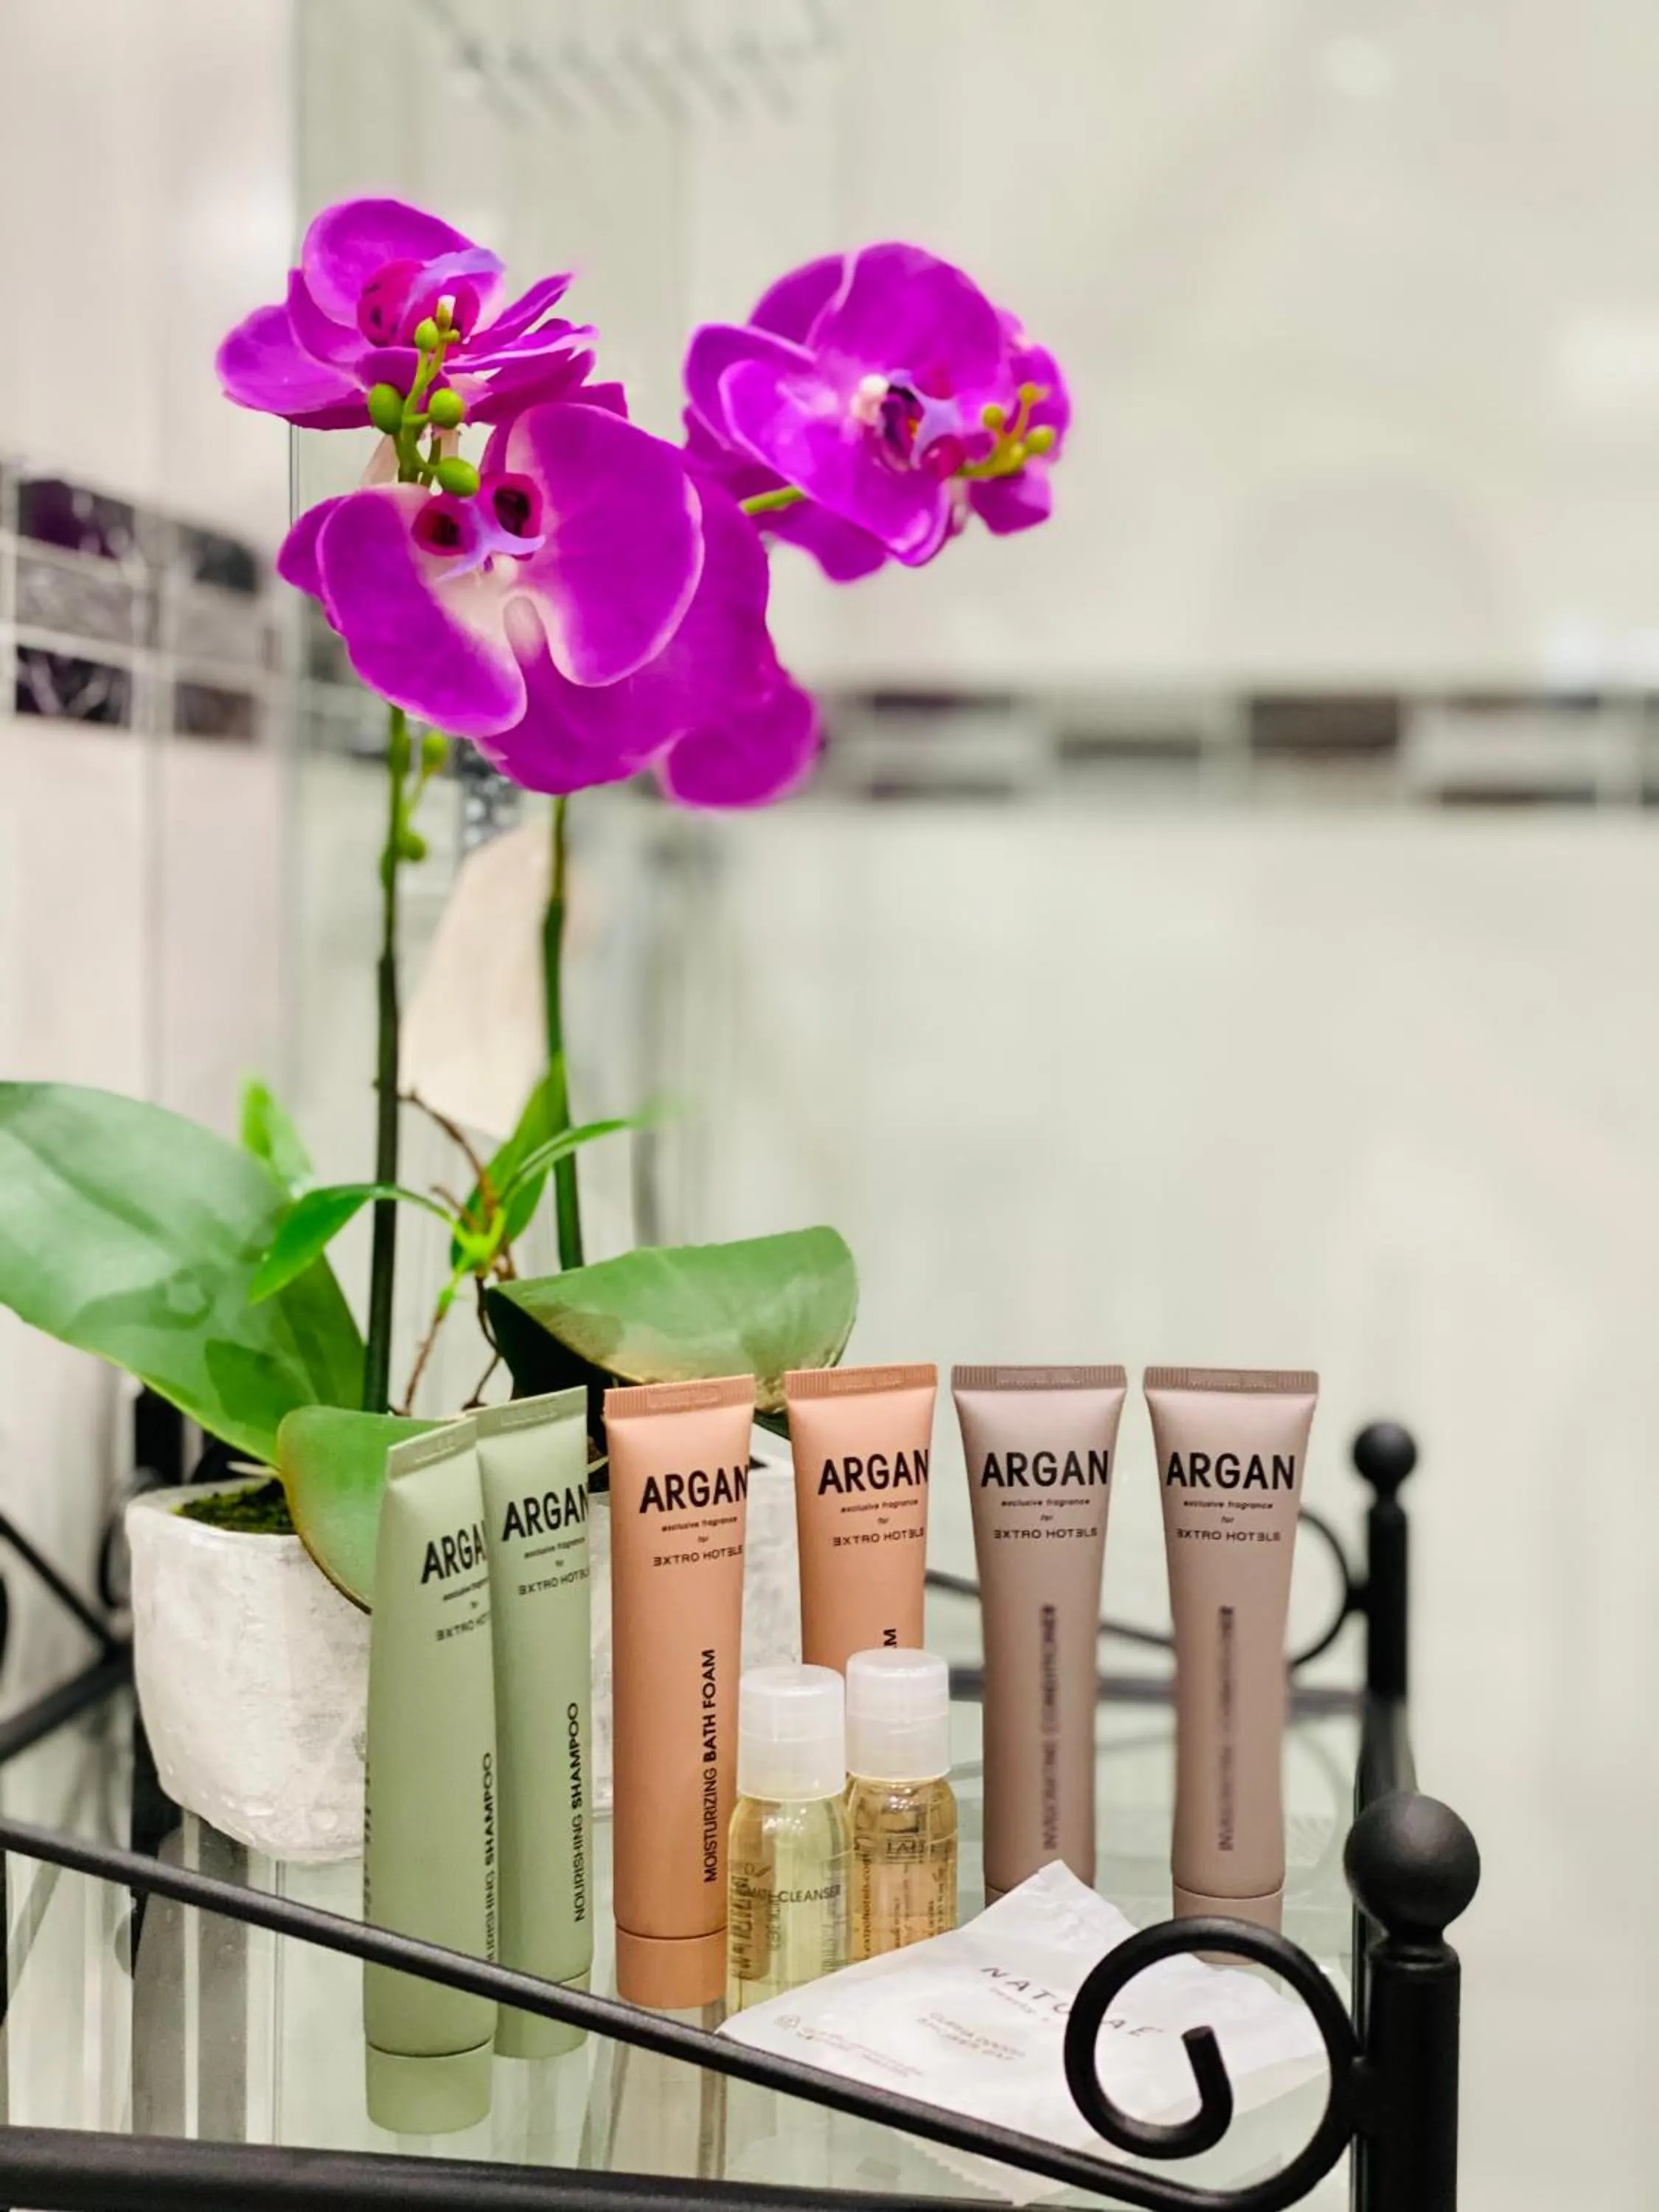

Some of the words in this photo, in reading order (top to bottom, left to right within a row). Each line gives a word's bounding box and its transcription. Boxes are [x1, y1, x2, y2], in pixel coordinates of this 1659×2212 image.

[639, 1464, 748, 1514] ARGAN
[818, 1449, 928, 1495] ARGAN
[981, 1450, 1107, 1487] ARGAN
[1166, 1452, 1295, 1489] ARGAN
[421, 1520, 487, 1584] ARGA
[701, 1649, 716, 1708] FOAM
[567, 1703, 582, 1809] SHAMPOO
[703, 1714, 717, 1762] BATH
[482, 1752, 495, 1866] SHAMPOO
[703, 1767, 718, 1882] MOISTURIZING
[571, 1814, 586, 1922] NOURISHING
